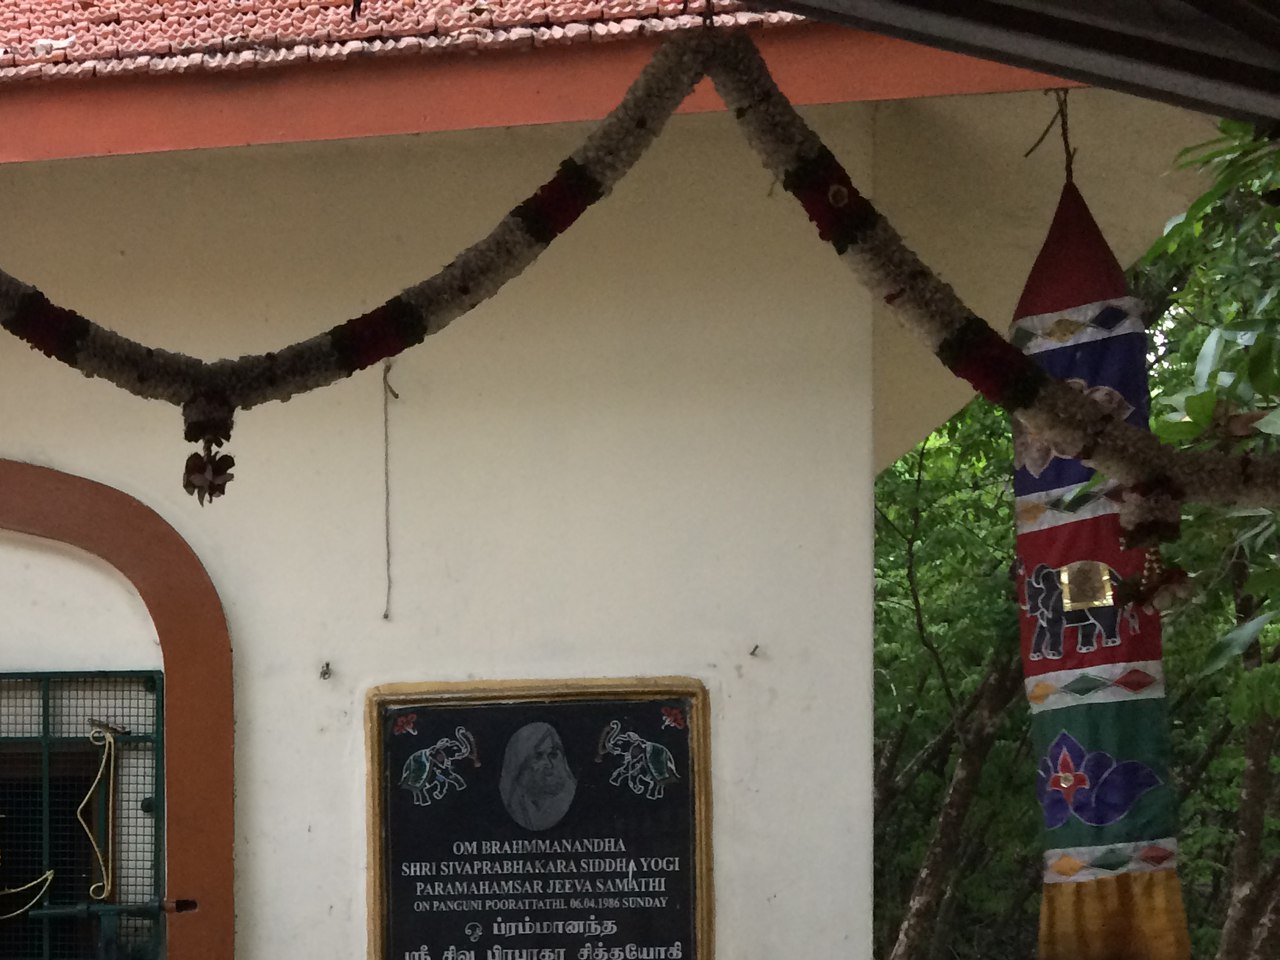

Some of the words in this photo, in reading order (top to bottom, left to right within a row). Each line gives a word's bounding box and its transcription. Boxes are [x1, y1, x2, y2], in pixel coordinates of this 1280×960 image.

[453, 841, 477, 855] OM
[482, 838, 626, 854] BRAHMMANANDHA
[401, 862, 436, 876] SHRI
[440, 859, 577, 876] SIVAPRABHAKARA
[580, 858, 637, 873] SIDDHA
[640, 857, 680, 871] YOGI
[415, 880, 543, 896] PARAMAHAMSAR
[546, 879, 592, 893] JEEVA
[596, 877, 666, 893] SAMATHI
[414, 901, 430, 911] ON
[433, 900, 482, 911] PANGUNI
[570, 898, 620, 909] 06.04.1986
[622, 897, 668, 908] SUNDAY
